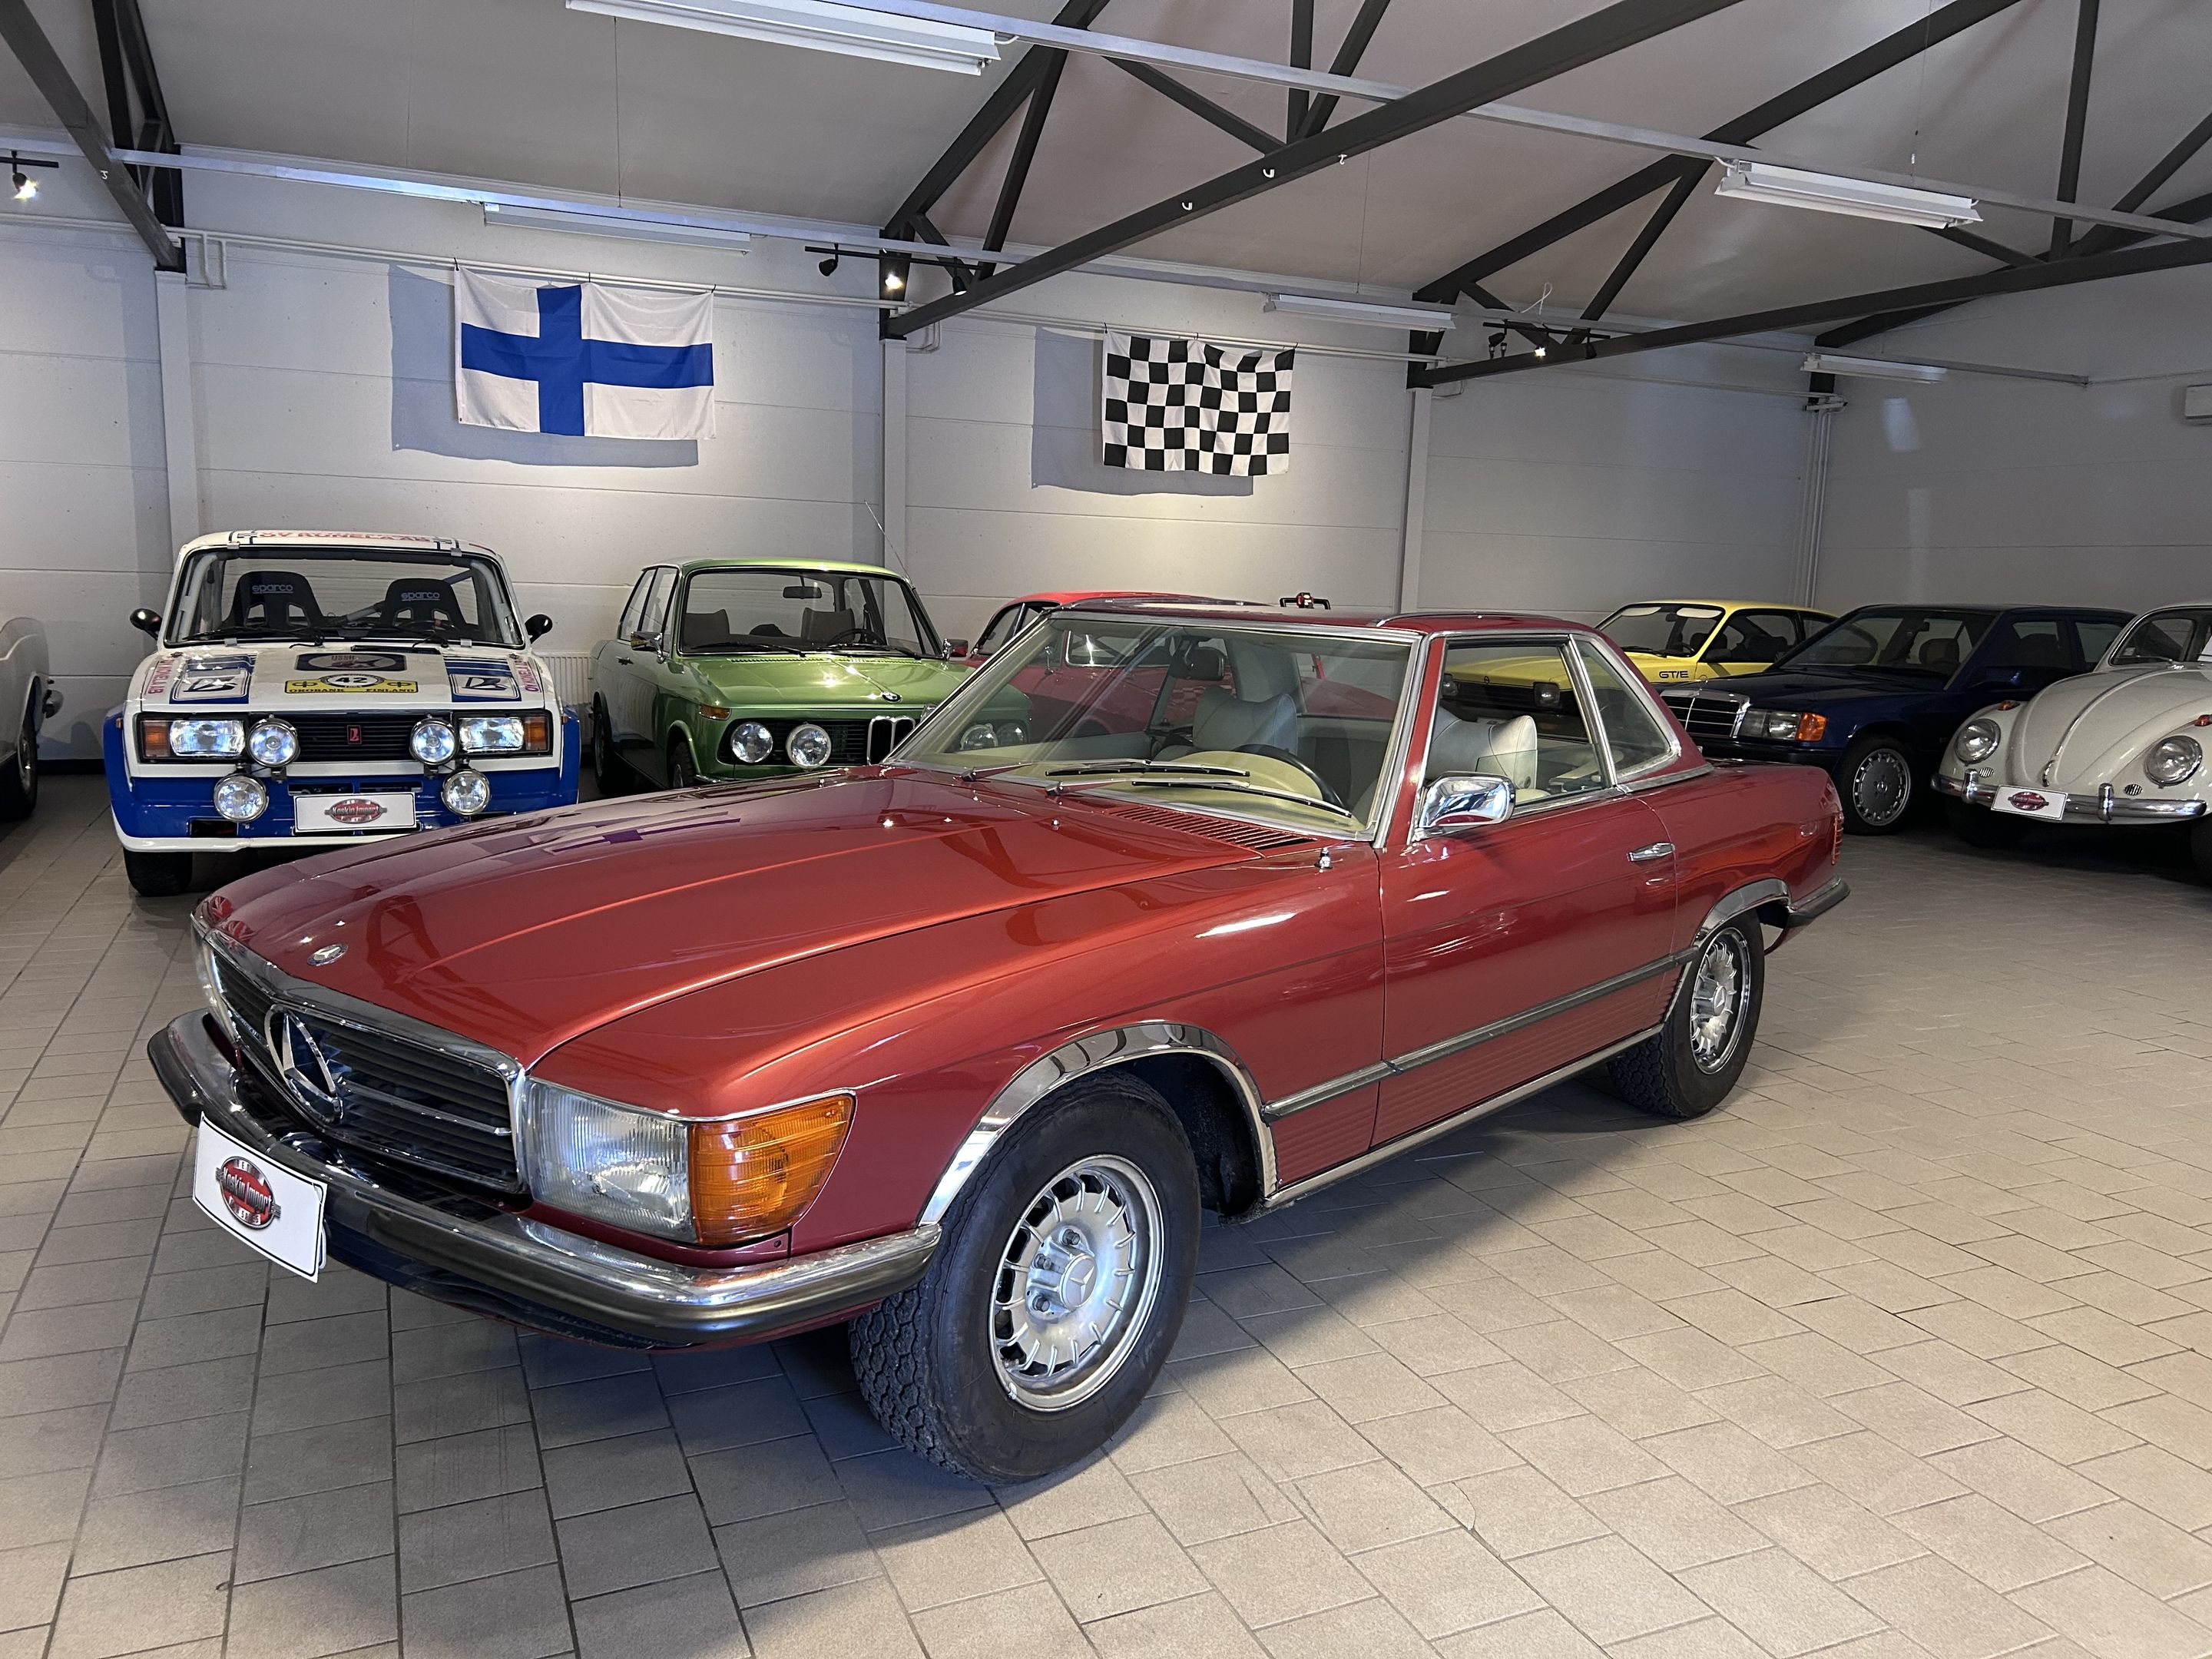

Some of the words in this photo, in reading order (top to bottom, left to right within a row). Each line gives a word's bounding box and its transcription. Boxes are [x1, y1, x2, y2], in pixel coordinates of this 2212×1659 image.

[252, 584, 293, 593] sparco
[401, 591, 441, 601] sparco
[222, 1167, 245, 1200] Koskin
[244, 1181, 272, 1214] Import
